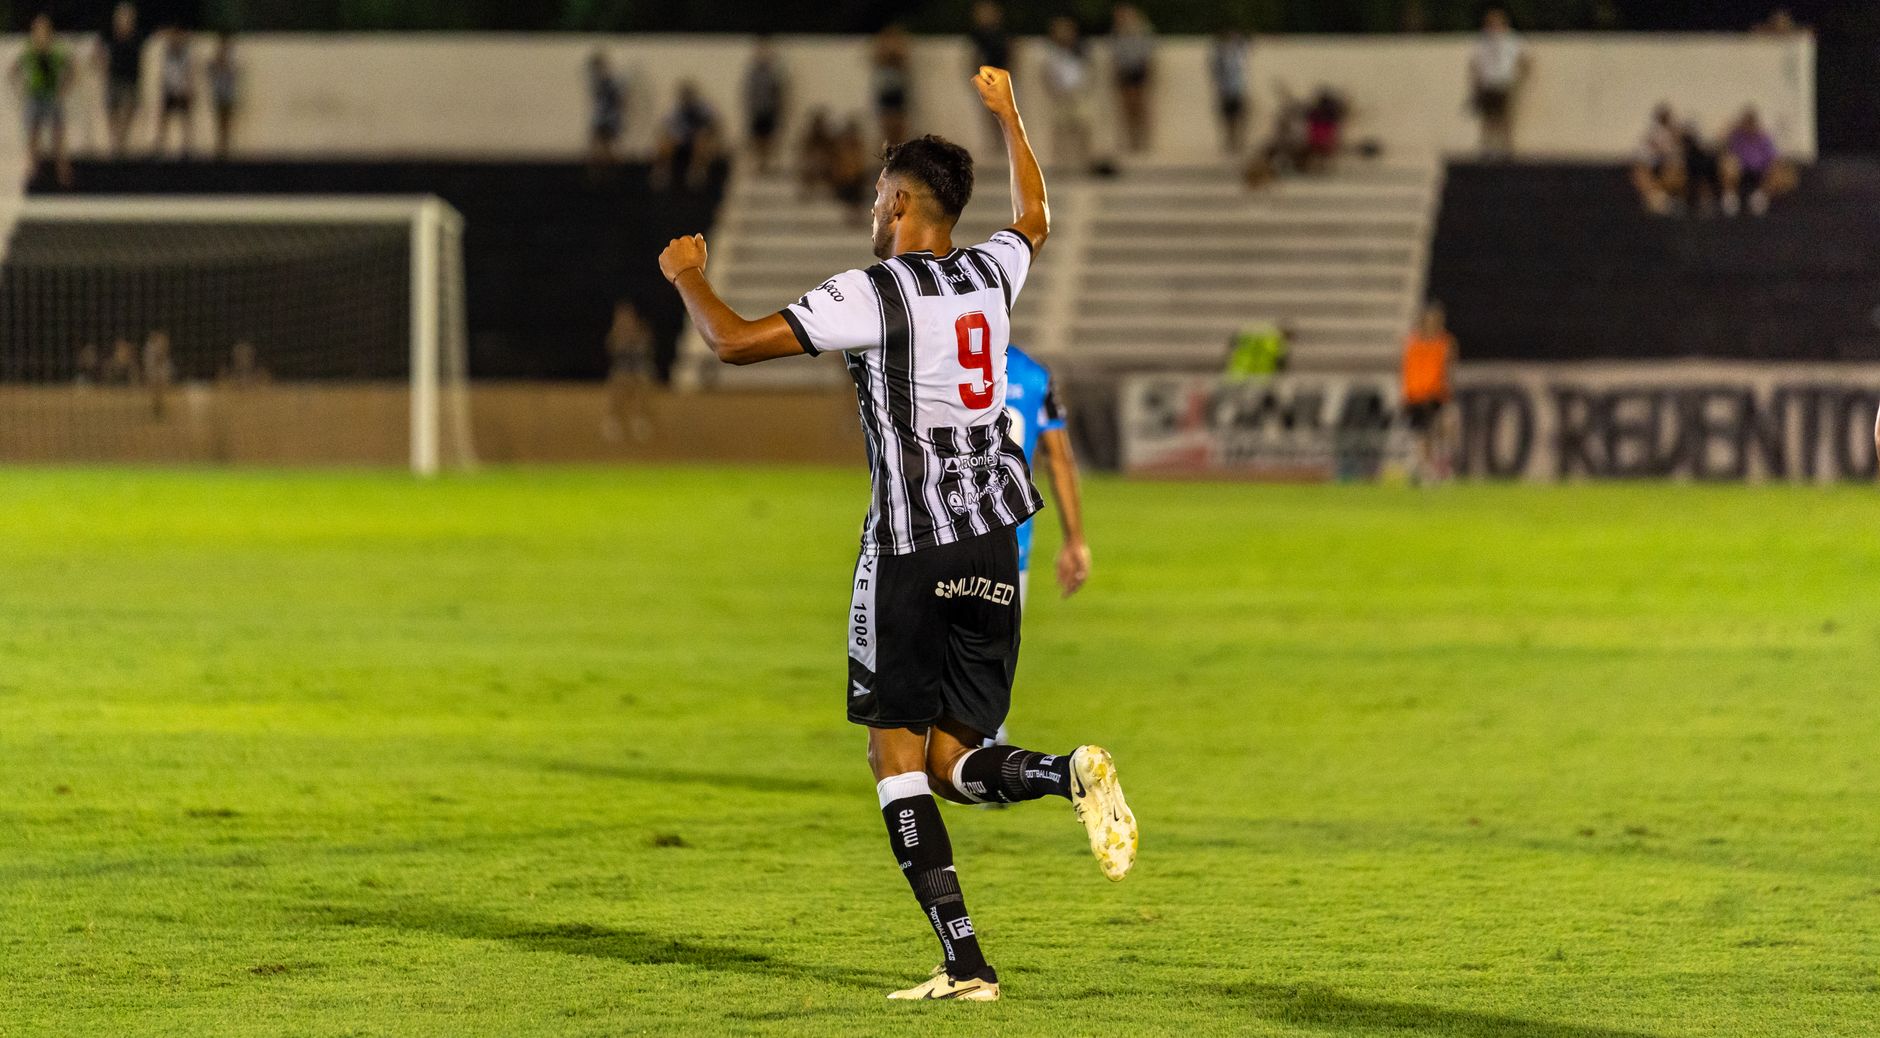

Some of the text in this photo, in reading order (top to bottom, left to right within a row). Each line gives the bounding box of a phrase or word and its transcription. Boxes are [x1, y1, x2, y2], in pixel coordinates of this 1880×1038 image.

[954, 309, 994, 410] 9
[854, 603, 868, 647] 1908
[898, 809, 920, 848] mitre
